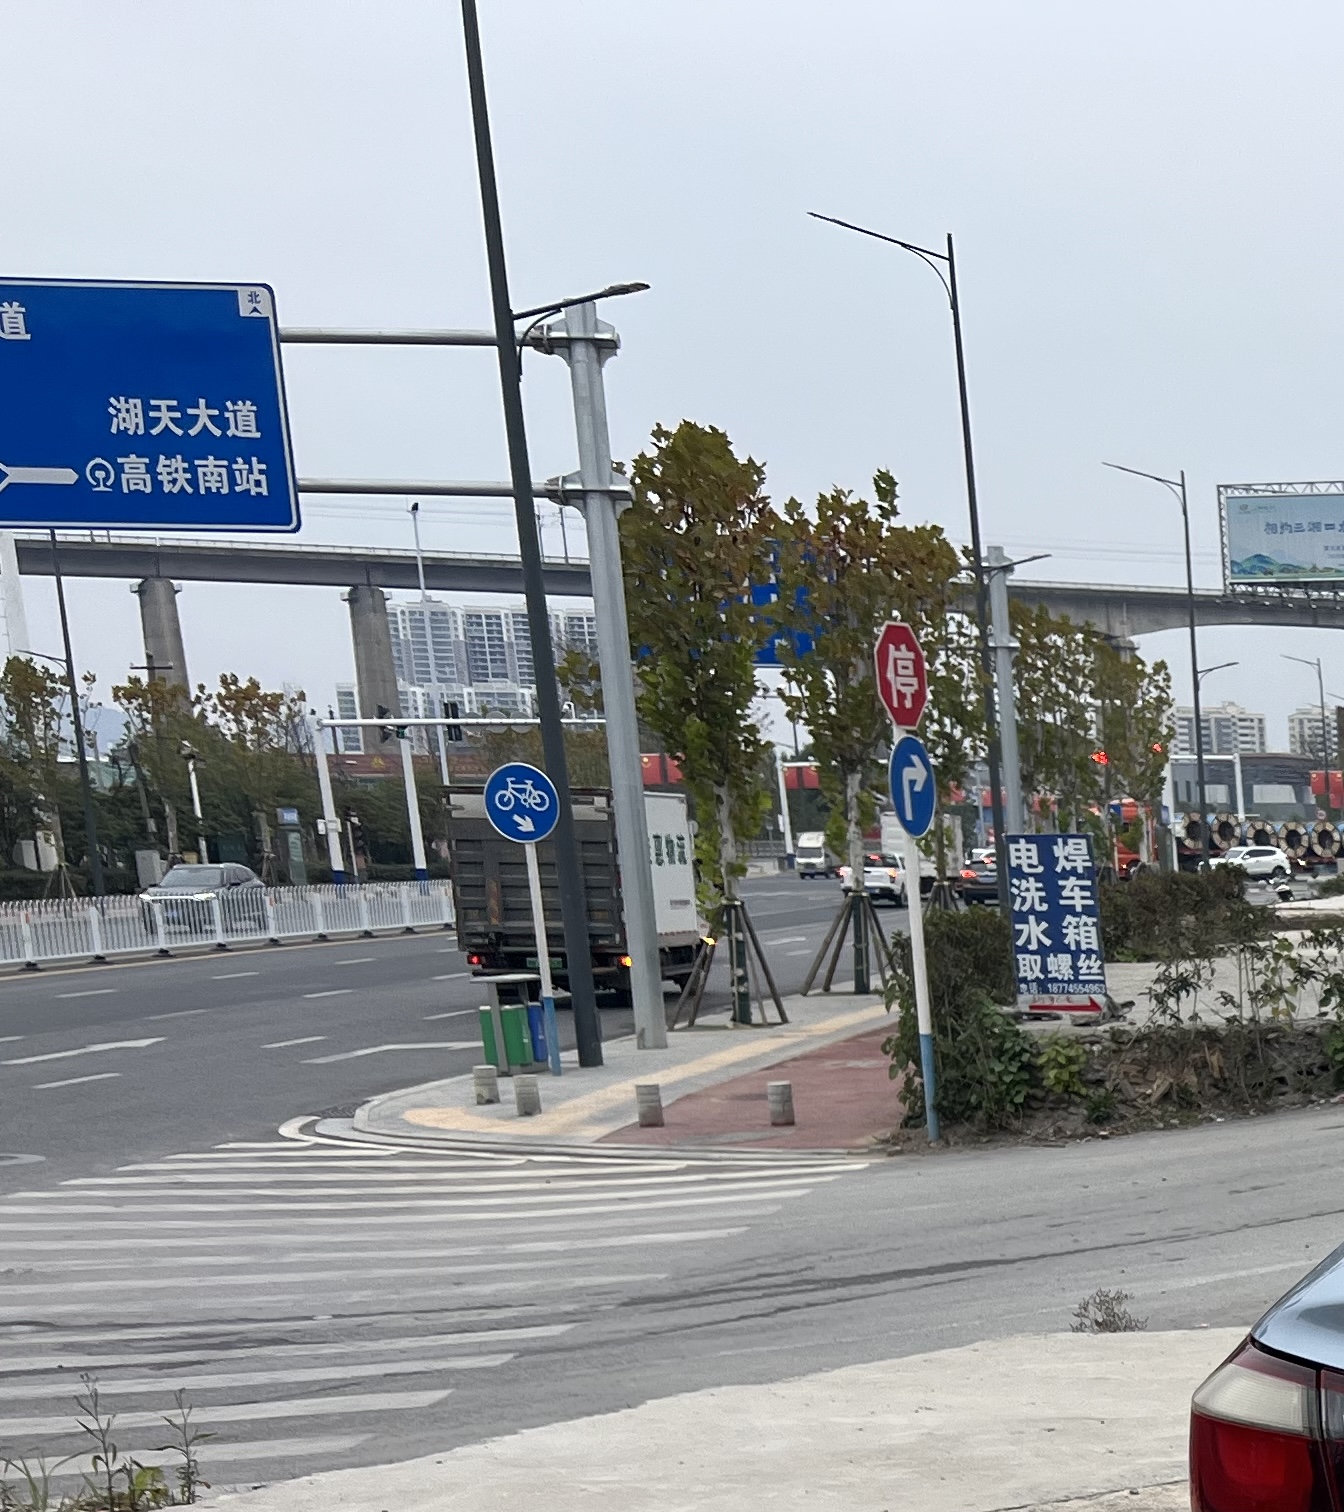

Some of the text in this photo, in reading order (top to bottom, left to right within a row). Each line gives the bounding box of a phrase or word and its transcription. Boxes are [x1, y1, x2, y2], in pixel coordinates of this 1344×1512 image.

[248, 291, 262, 304] 北
[0, 301, 31, 340] 道
[107, 396, 261, 438] 湖天大道
[116, 454, 268, 496] 高铁南站
[886, 643, 919, 709] 停
[1008, 837, 1093, 874] 电焊
[1010, 876, 1095, 913] 洗车
[1014, 914, 1100, 951] 水箱
[1016, 952, 1105, 981] 取螺丝
